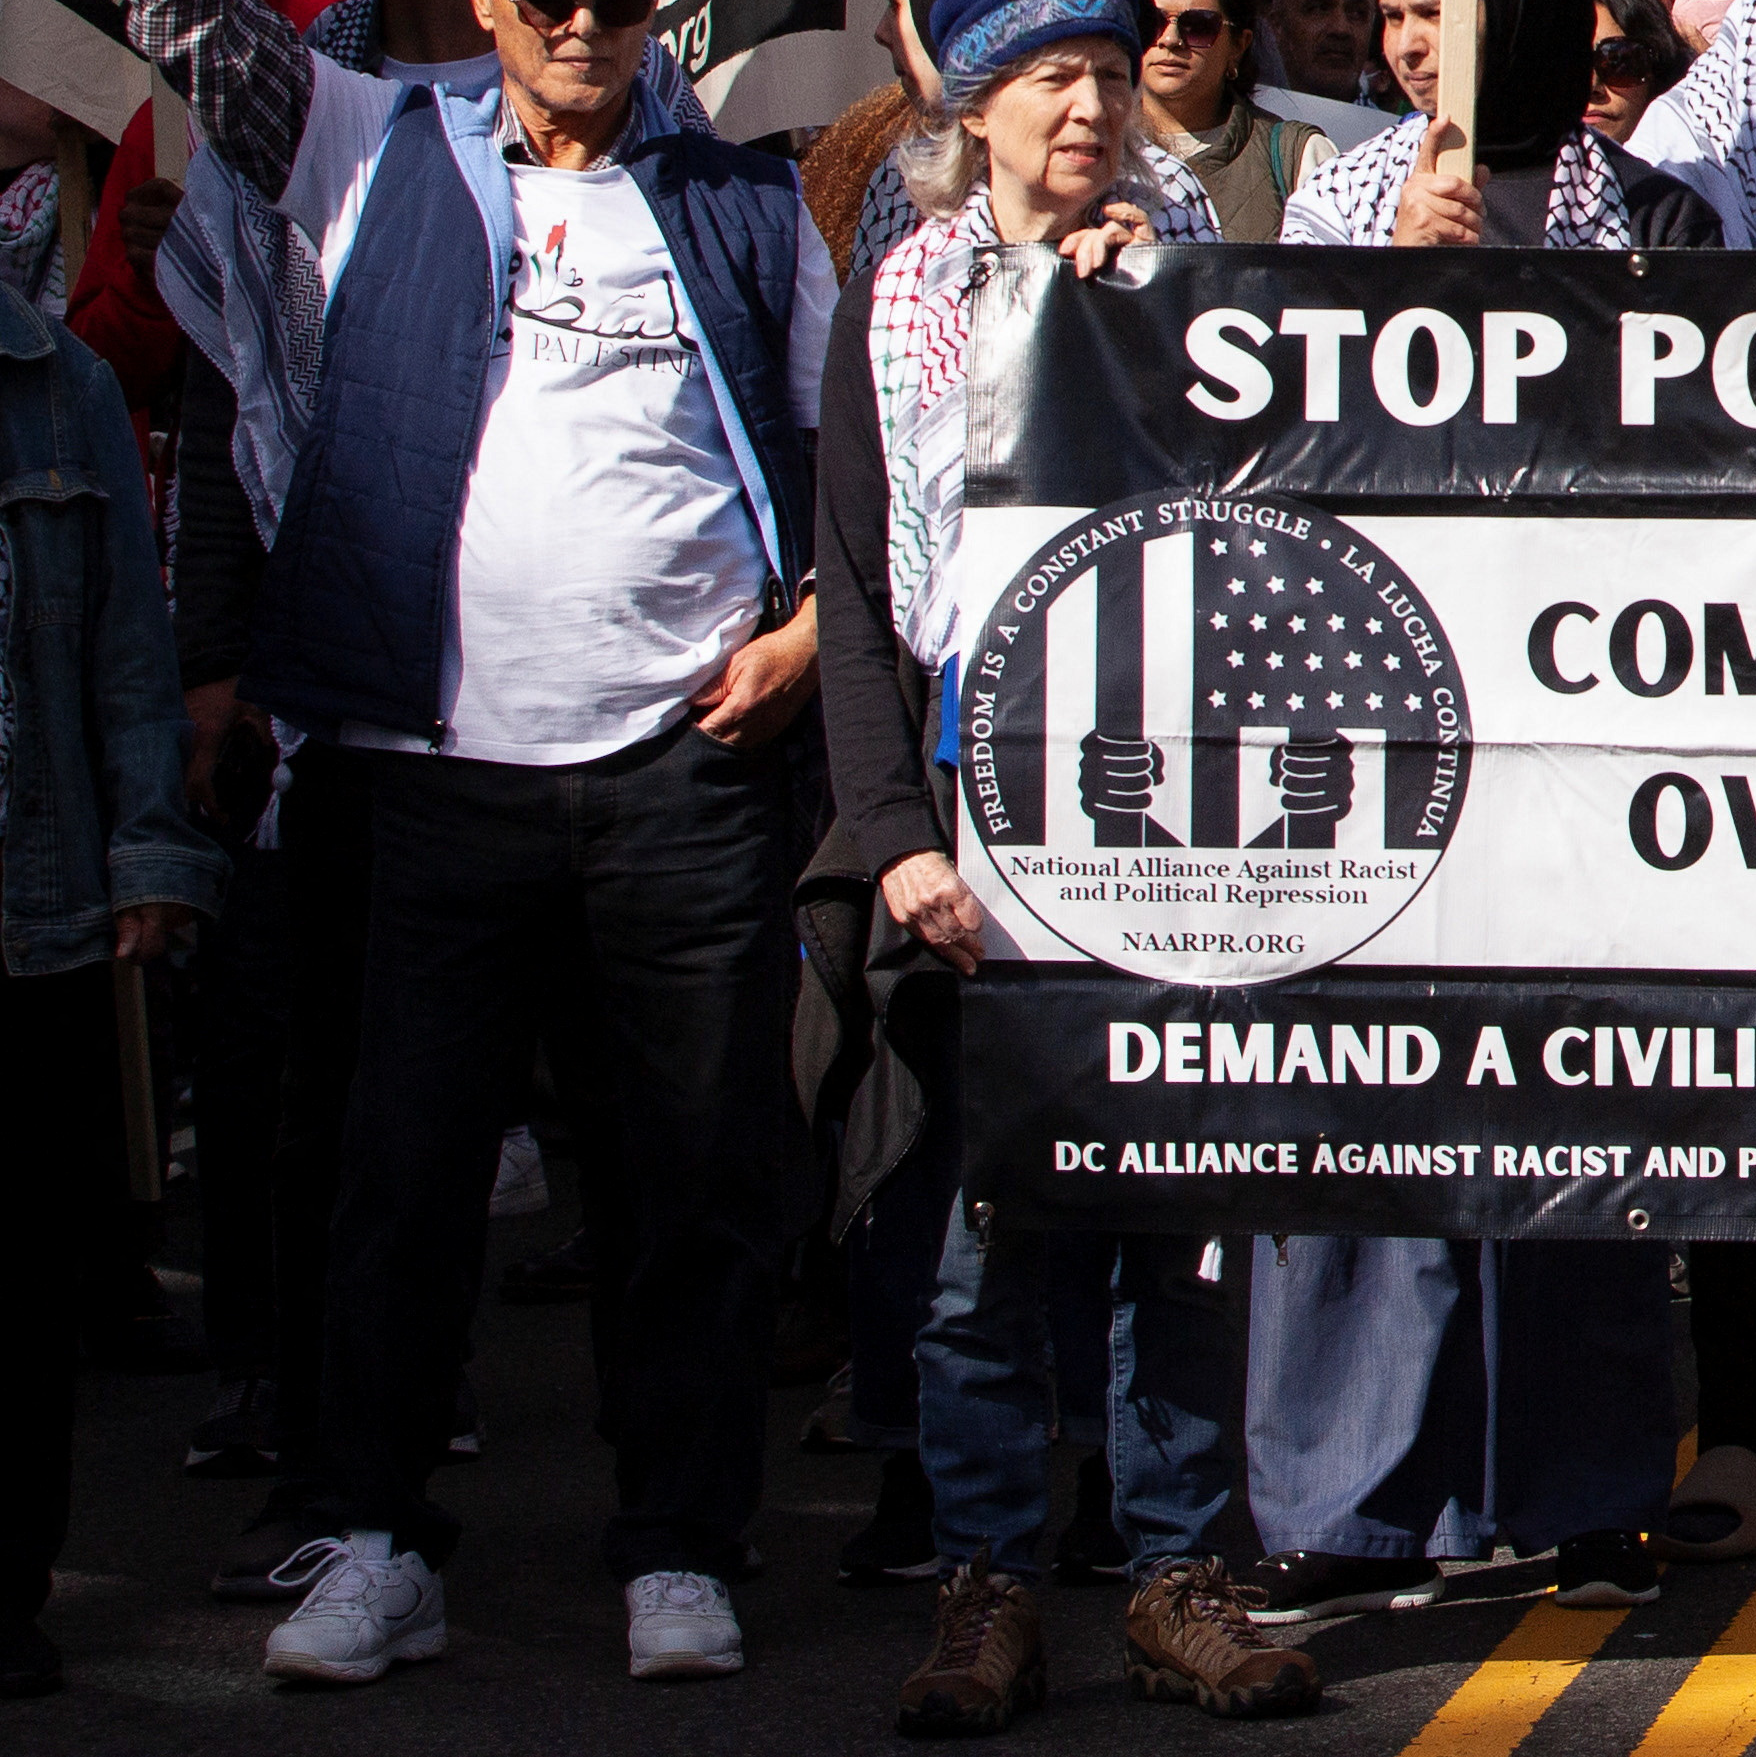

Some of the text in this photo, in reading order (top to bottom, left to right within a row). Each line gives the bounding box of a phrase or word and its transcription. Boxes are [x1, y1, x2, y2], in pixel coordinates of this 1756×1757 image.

[1184, 306, 1568, 428] STOP
[972, 497, 1459, 838] FREEDOM IS A CONSTANT STRUGGLE LA LUCHA CONTINUA
[1010, 856, 1418, 885] National Alliance Against Racist
[1060, 882, 1369, 909] and Political Repression
[1121, 931, 1305, 955] NAARPR.ORG
[1108, 1020, 1441, 1088] DEMAND
[1465, 1022, 1518, 1087] A
[1054, 1140, 1107, 1175] DC
[1117, 1140, 1299, 1177] ALLIANCE
[1311, 1141, 1482, 1179] AGAINST
[1493, 1143, 1632, 1180] RACIST
[1643, 1144, 1726, 1181] AND
